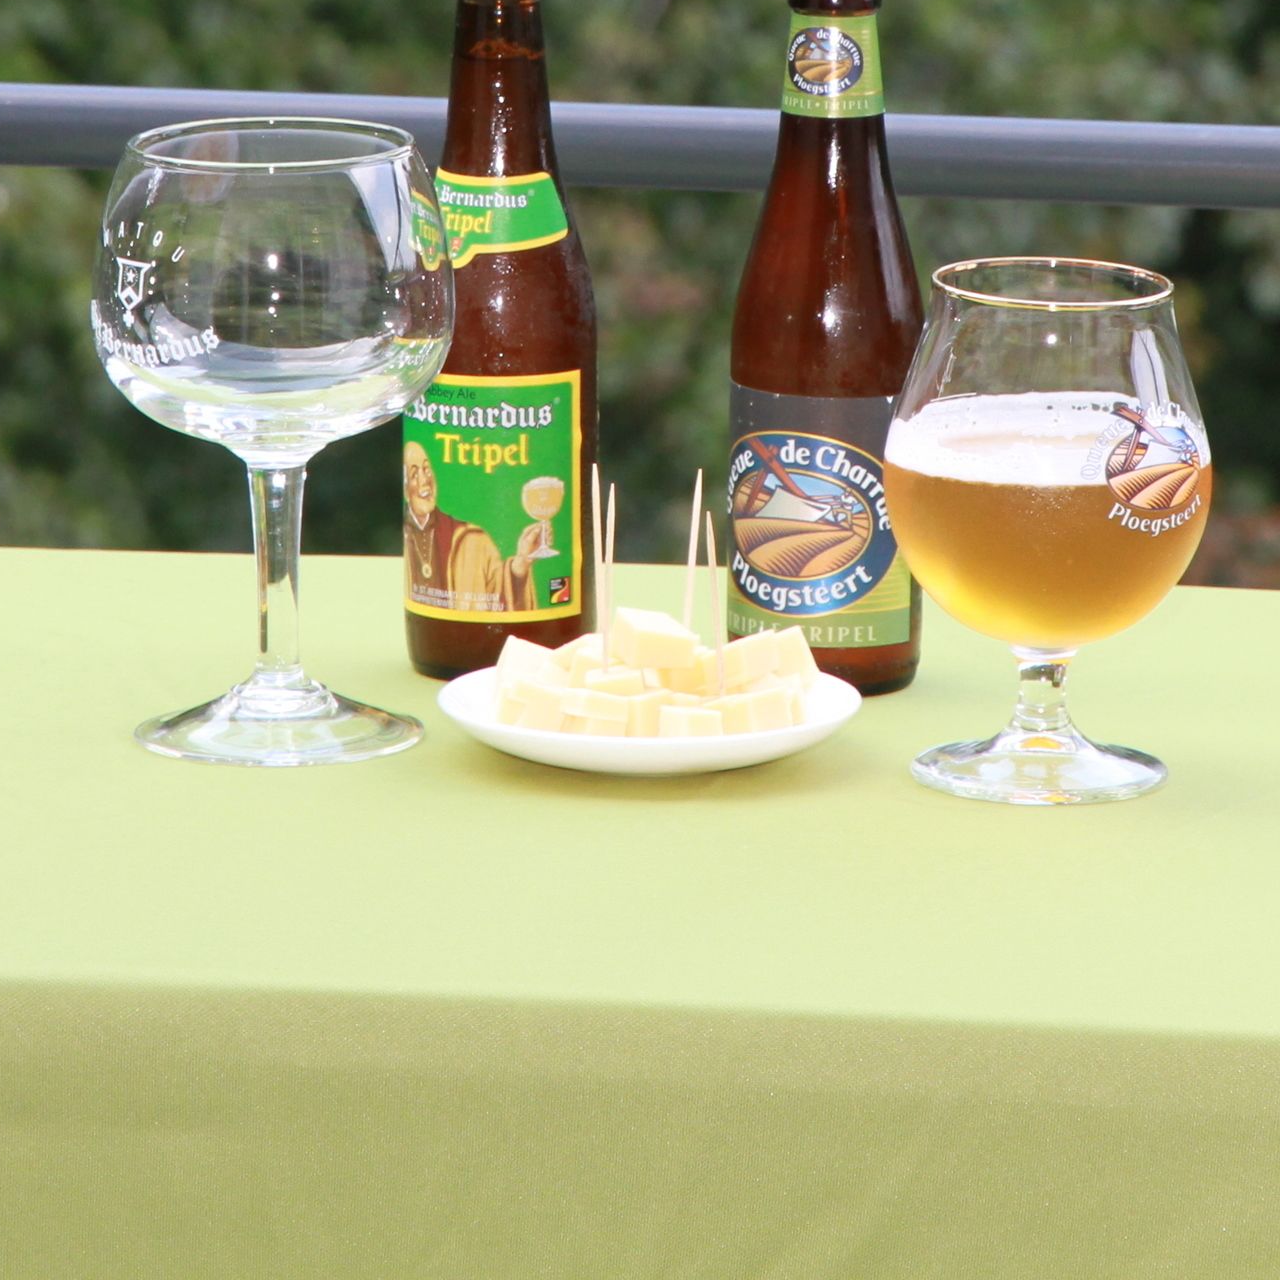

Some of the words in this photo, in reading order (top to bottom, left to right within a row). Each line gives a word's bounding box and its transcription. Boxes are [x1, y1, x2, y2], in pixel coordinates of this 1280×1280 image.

[439, 184, 528, 208] Bernardus
[412, 396, 553, 430] Bernardus
[457, 387, 477, 400] Ale
[434, 432, 530, 474] Tripel
[1081, 418, 1131, 481] Queue
[779, 439, 811, 466] de
[815, 445, 892, 532] Charrue
[1108, 493, 1202, 538] Ploegsteert
[732, 551, 873, 612] Ploegsteert
